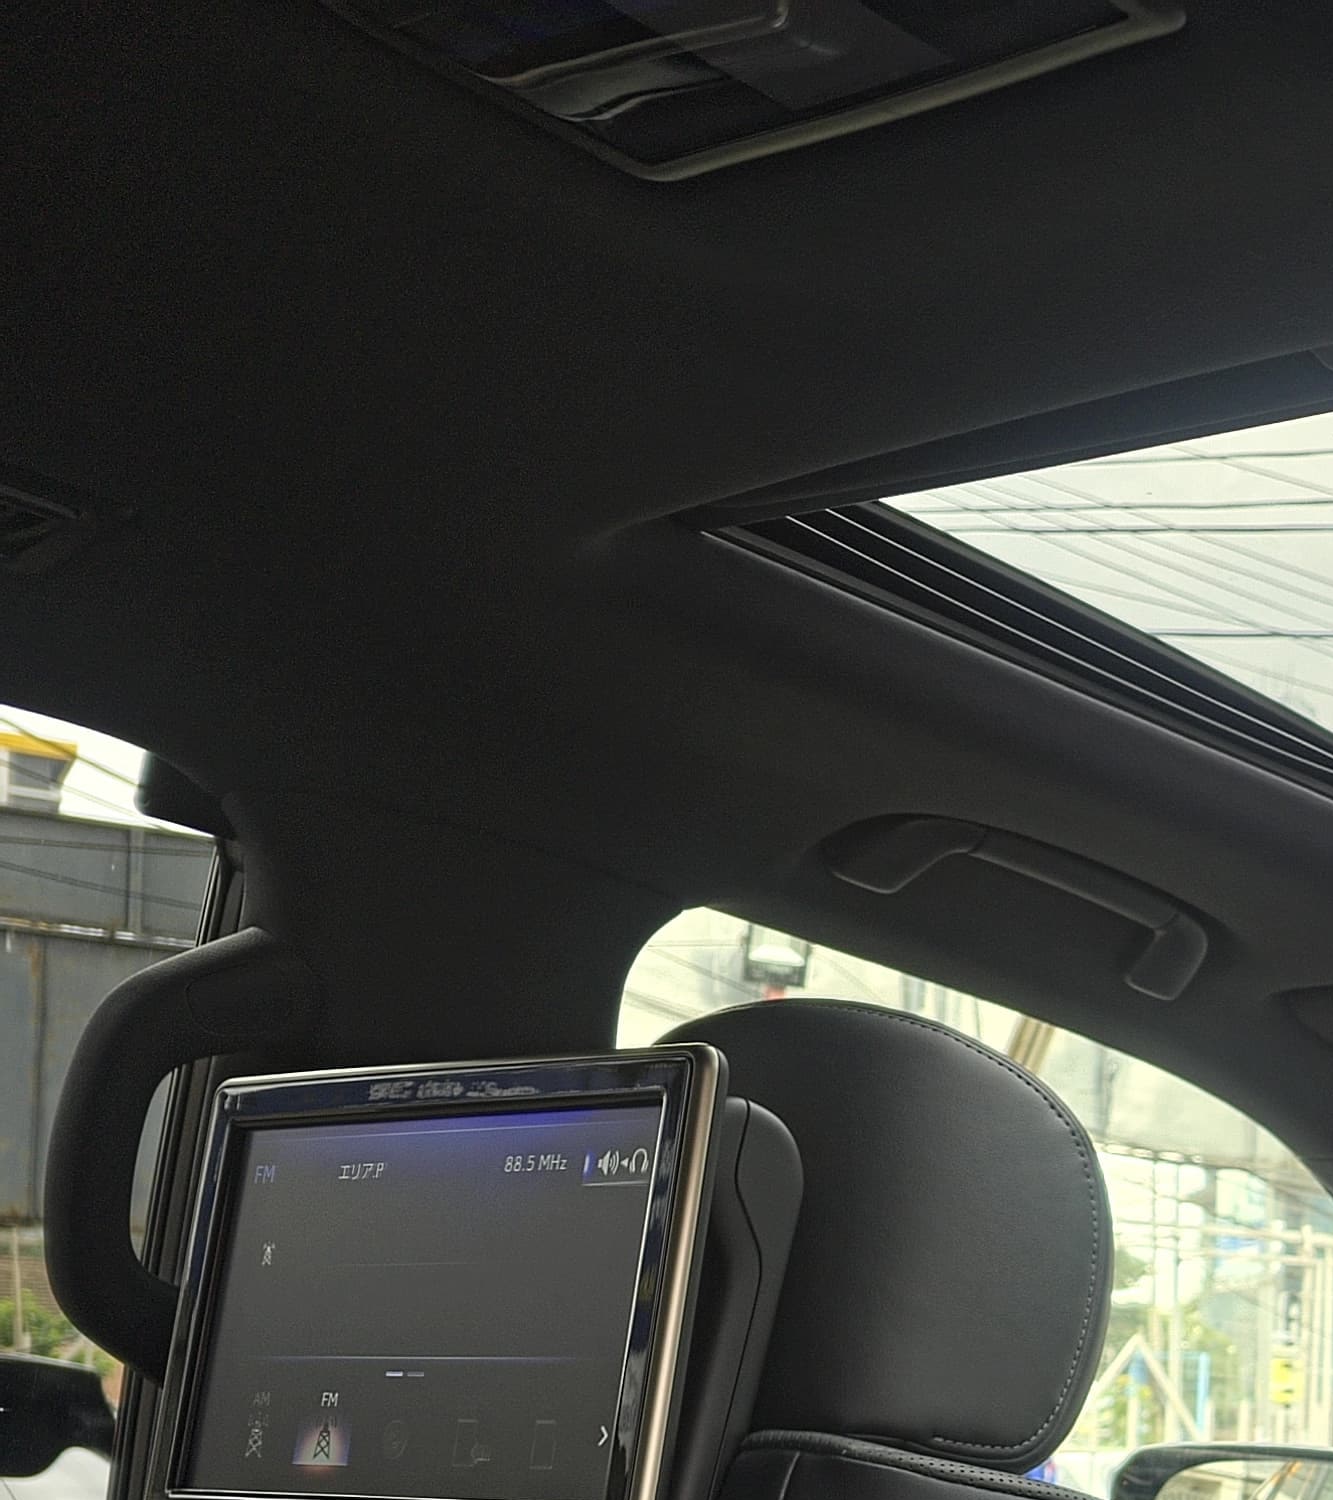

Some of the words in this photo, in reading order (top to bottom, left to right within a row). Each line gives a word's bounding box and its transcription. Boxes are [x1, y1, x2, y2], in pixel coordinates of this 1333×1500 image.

[337, 1161, 386, 1181] エリア.P
[503, 1154, 536, 1173] 88.5
[537, 1153, 569, 1171] MHz
[254, 1164, 277, 1185] FM
[253, 1391, 271, 1407] AM
[320, 1391, 340, 1408] FM
